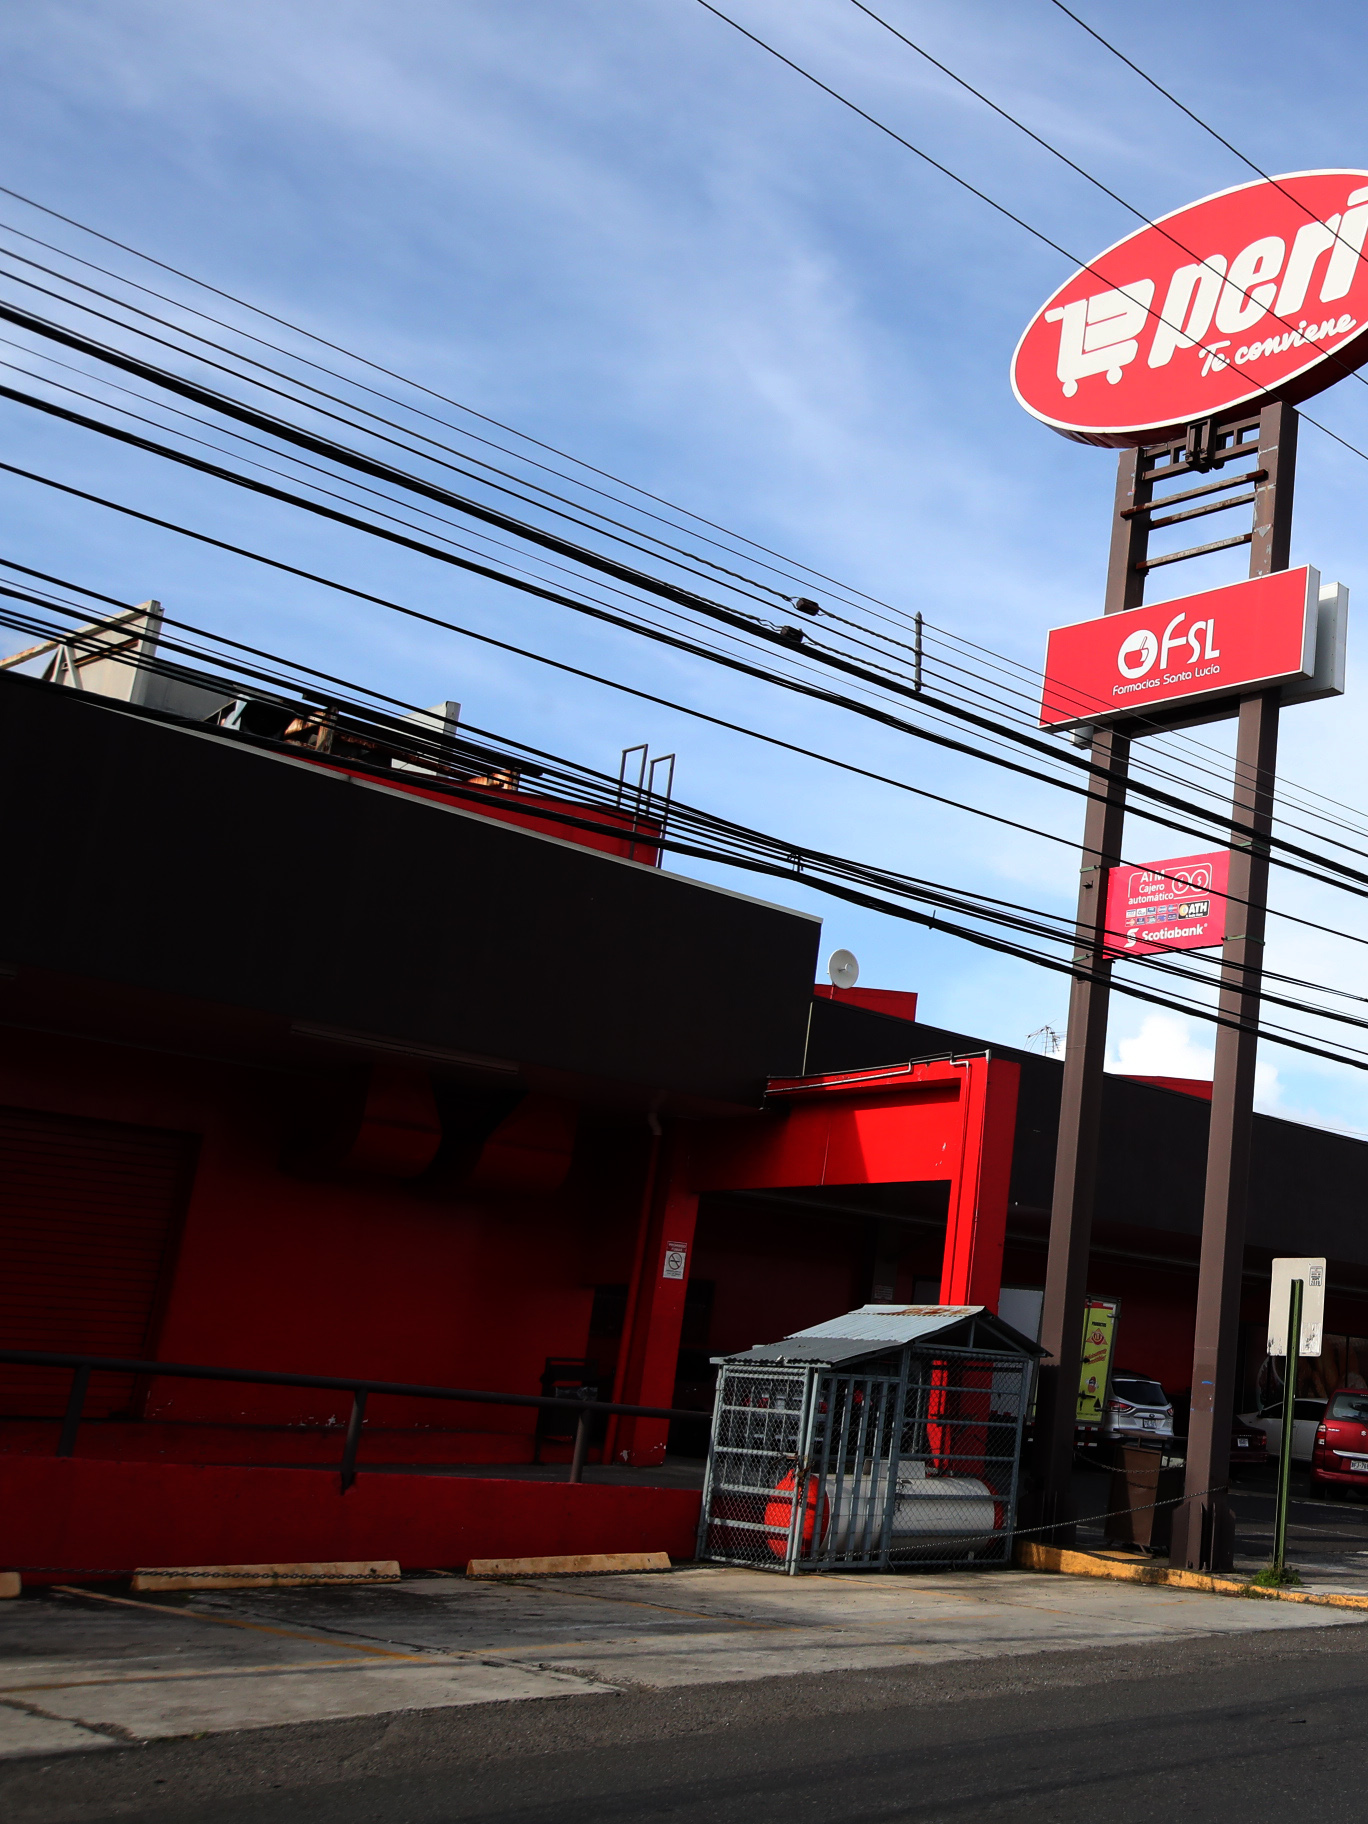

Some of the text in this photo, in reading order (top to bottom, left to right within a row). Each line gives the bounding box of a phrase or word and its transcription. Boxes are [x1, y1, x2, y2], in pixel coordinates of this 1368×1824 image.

[1198, 314, 1358, 377] Te conviene
[1160, 612, 1221, 669] FSL
[1112, 664, 1221, 696] Farmacias Santa Lucía
[1140, 869, 1166, 882] ATM
[1138, 883, 1165, 894] Cajero
[1128, 892, 1174, 905] automático
[1188, 902, 1208, 914] ATH
[1142, 923, 1204, 941] Scotiabank
